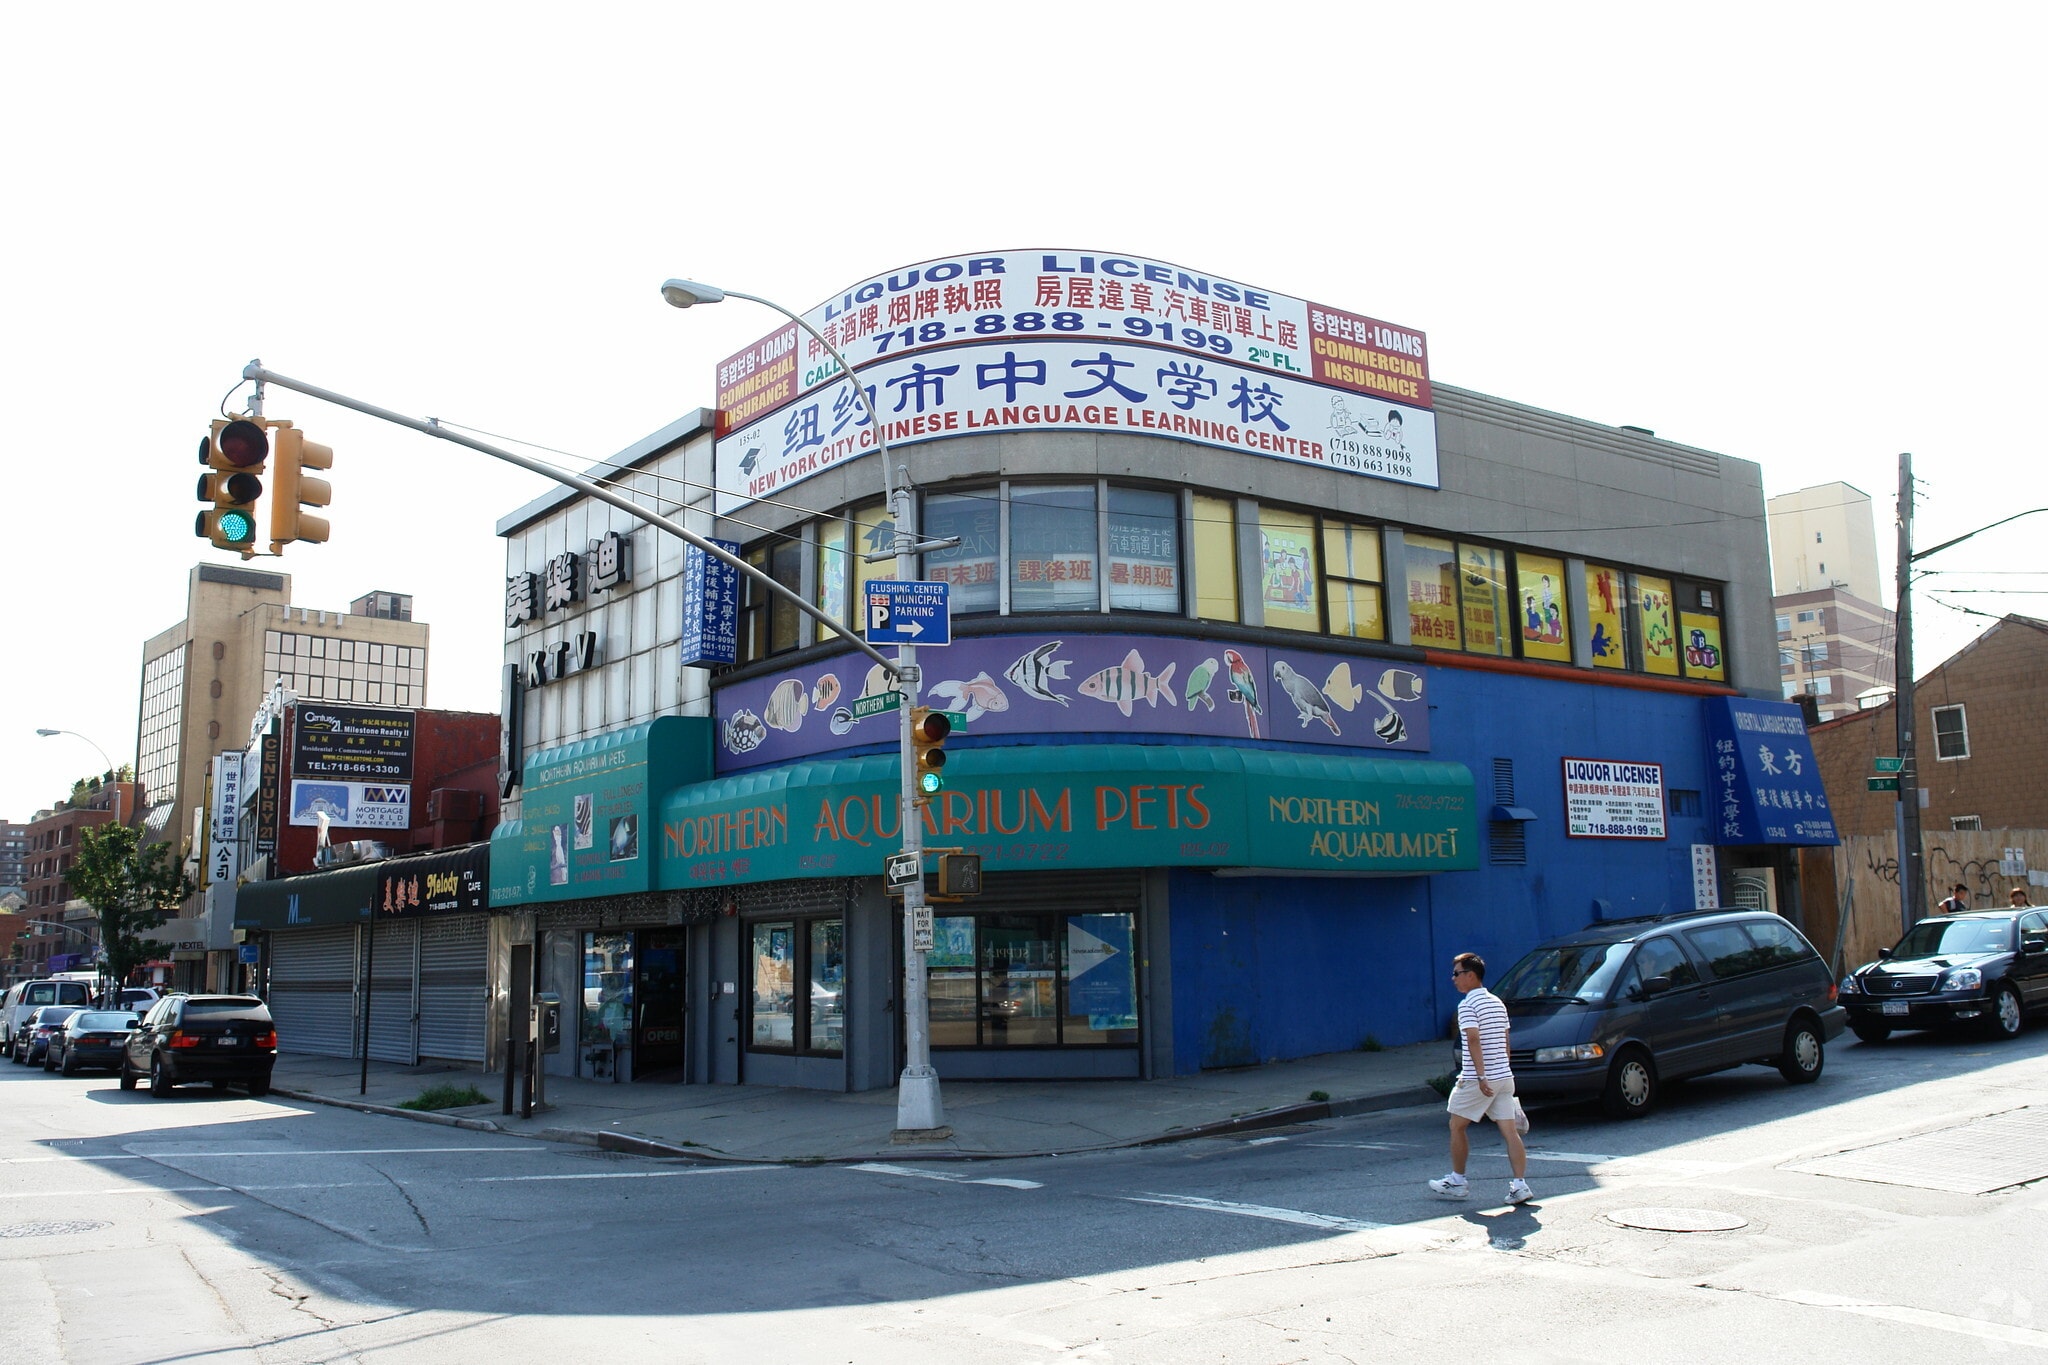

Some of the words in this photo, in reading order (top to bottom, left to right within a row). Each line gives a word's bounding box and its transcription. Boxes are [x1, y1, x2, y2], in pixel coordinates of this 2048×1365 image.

[825, 257, 1006, 322] LIQUOR
[1042, 255, 1270, 311] LICENSE
[760, 326, 796, 365] LOANS
[872, 312, 1233, 355] 718-888-9199
[1374, 327, 1423, 358] LOANS
[1272, 352, 1302, 373] FL.
[1314, 336, 1425, 380] COMMERCIAL
[719, 354, 796, 410] COMMERCIAL
[1324, 360, 1419, 398] INSURANCE
[724, 378, 790, 428] INSURANCE
[783, 351, 1291, 457] 纽约市中文学校
[749, 470, 777, 496] NEW
[780, 456, 817, 487] YORK
[821, 433, 855, 464] CITY
[860, 411, 959, 449] CHINESE
[967, 404, 1118, 428] LANGUAGE
[1127, 407, 1240, 445] LEARNING
[1246, 429, 1324, 460] CENTER
[1330, 437, 1360, 455] (718)
[1362, 442, 1383, 458] 888
[1385, 447, 1412, 463] 9098
[1330, 451, 1360, 469] (718)
[1364, 456, 1383, 472] 663
[1386, 460, 1412, 477] 1898
[1019, 560, 1092, 582] 課後班
[1110, 562, 1174, 588] 暑期班
[871, 584, 910, 593] FLUSHING
[914, 585, 944, 594] CENTER
[895, 595, 944, 605] MUNICIPAL
[895, 606, 934, 617] PARKING
[527, 631, 597, 688] KTV
[304, 711, 335, 724] Century
[856, 697, 885, 715] NORTHERN
[344, 726, 379, 735] Milestone
[380, 728, 403, 738] Realty
[307, 762, 400, 774] TEL:718-661-3300
[540, 763, 571, 783] NORTHERN
[573, 755, 607, 774] AQUARIUM
[609, 750, 626, 765] PETS
[1567, 762, 1610, 781] LIQUOR
[1613, 765, 1659, 784] LICENSE
[1758, 744, 1802, 776] 東方
[262, 738, 277, 824] CENTURY
[1716, 739, 1744, 837] 紐約中文學校
[356, 806, 404, 814] MORTGAGE
[356, 813, 404, 821] WORLD
[664, 803, 787, 859] NORTHERN
[1094, 784, 1211, 831] PETS
[1269, 796, 1380, 825] NORTHERN
[260, 827, 273, 839] 21
[1588, 823, 1648, 835] 718-888-9199
[1310, 830, 1421, 862] AQUARIUM
[1424, 828, 1458, 858] PET
[892, 864, 901, 877] ONE
[905, 862, 915, 874] WAY
[426, 871, 459, 900] Melody
[468, 882, 481, 891] CAFE
[916, 911, 930, 919] WAIT
[917, 920, 929, 928] FOR
[179, 942, 205, 950] NEXTEL
